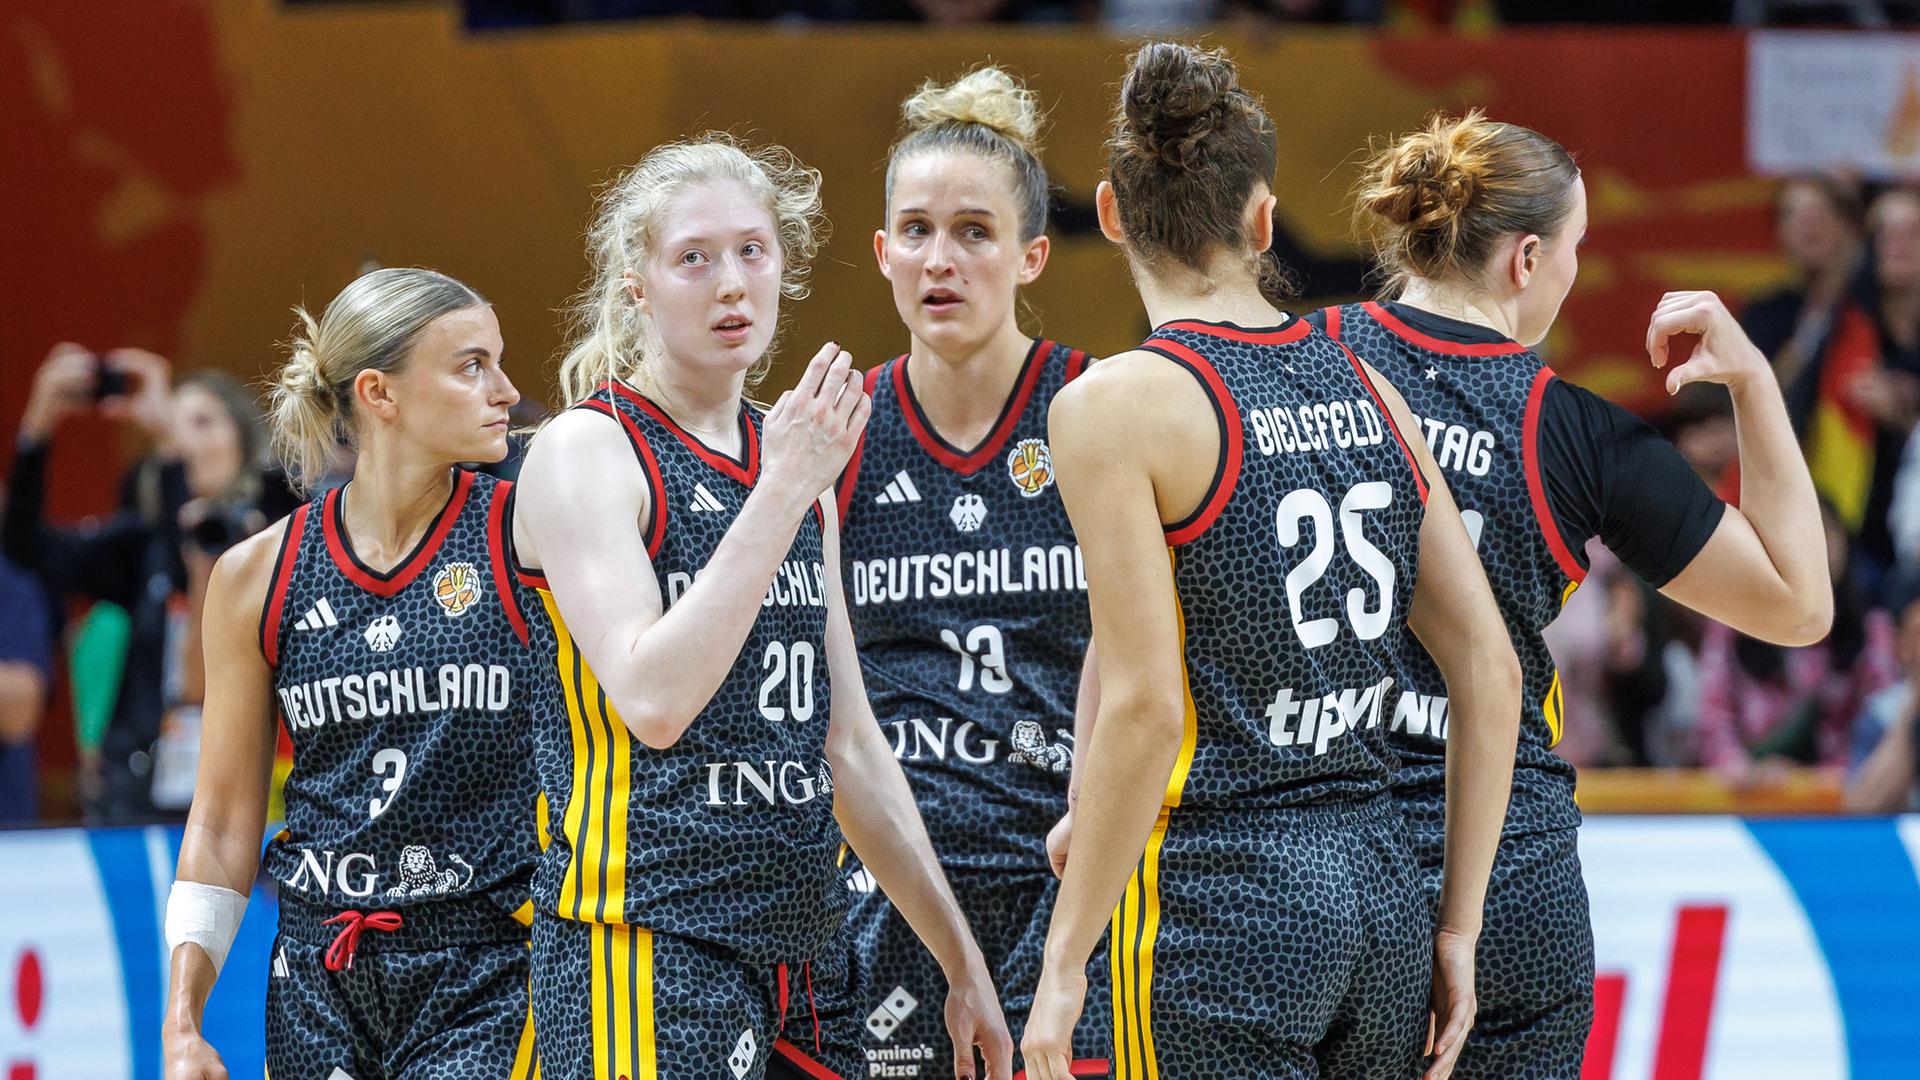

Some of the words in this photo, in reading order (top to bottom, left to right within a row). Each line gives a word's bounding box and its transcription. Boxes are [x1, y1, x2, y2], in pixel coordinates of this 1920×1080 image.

[1250, 399, 1384, 456] BIELEFELD
[1276, 481, 1396, 649] 25
[758, 641, 815, 722] 20
[940, 625, 1013, 693] 13
[278, 663, 509, 732] DEUTSCHLAND
[890, 718, 1000, 764] ING
[370, 748, 407, 820] 3
[705, 760, 817, 805] ING
[861, 1043, 934, 1062] omino's
[869, 1062, 918, 1078] Pizza
